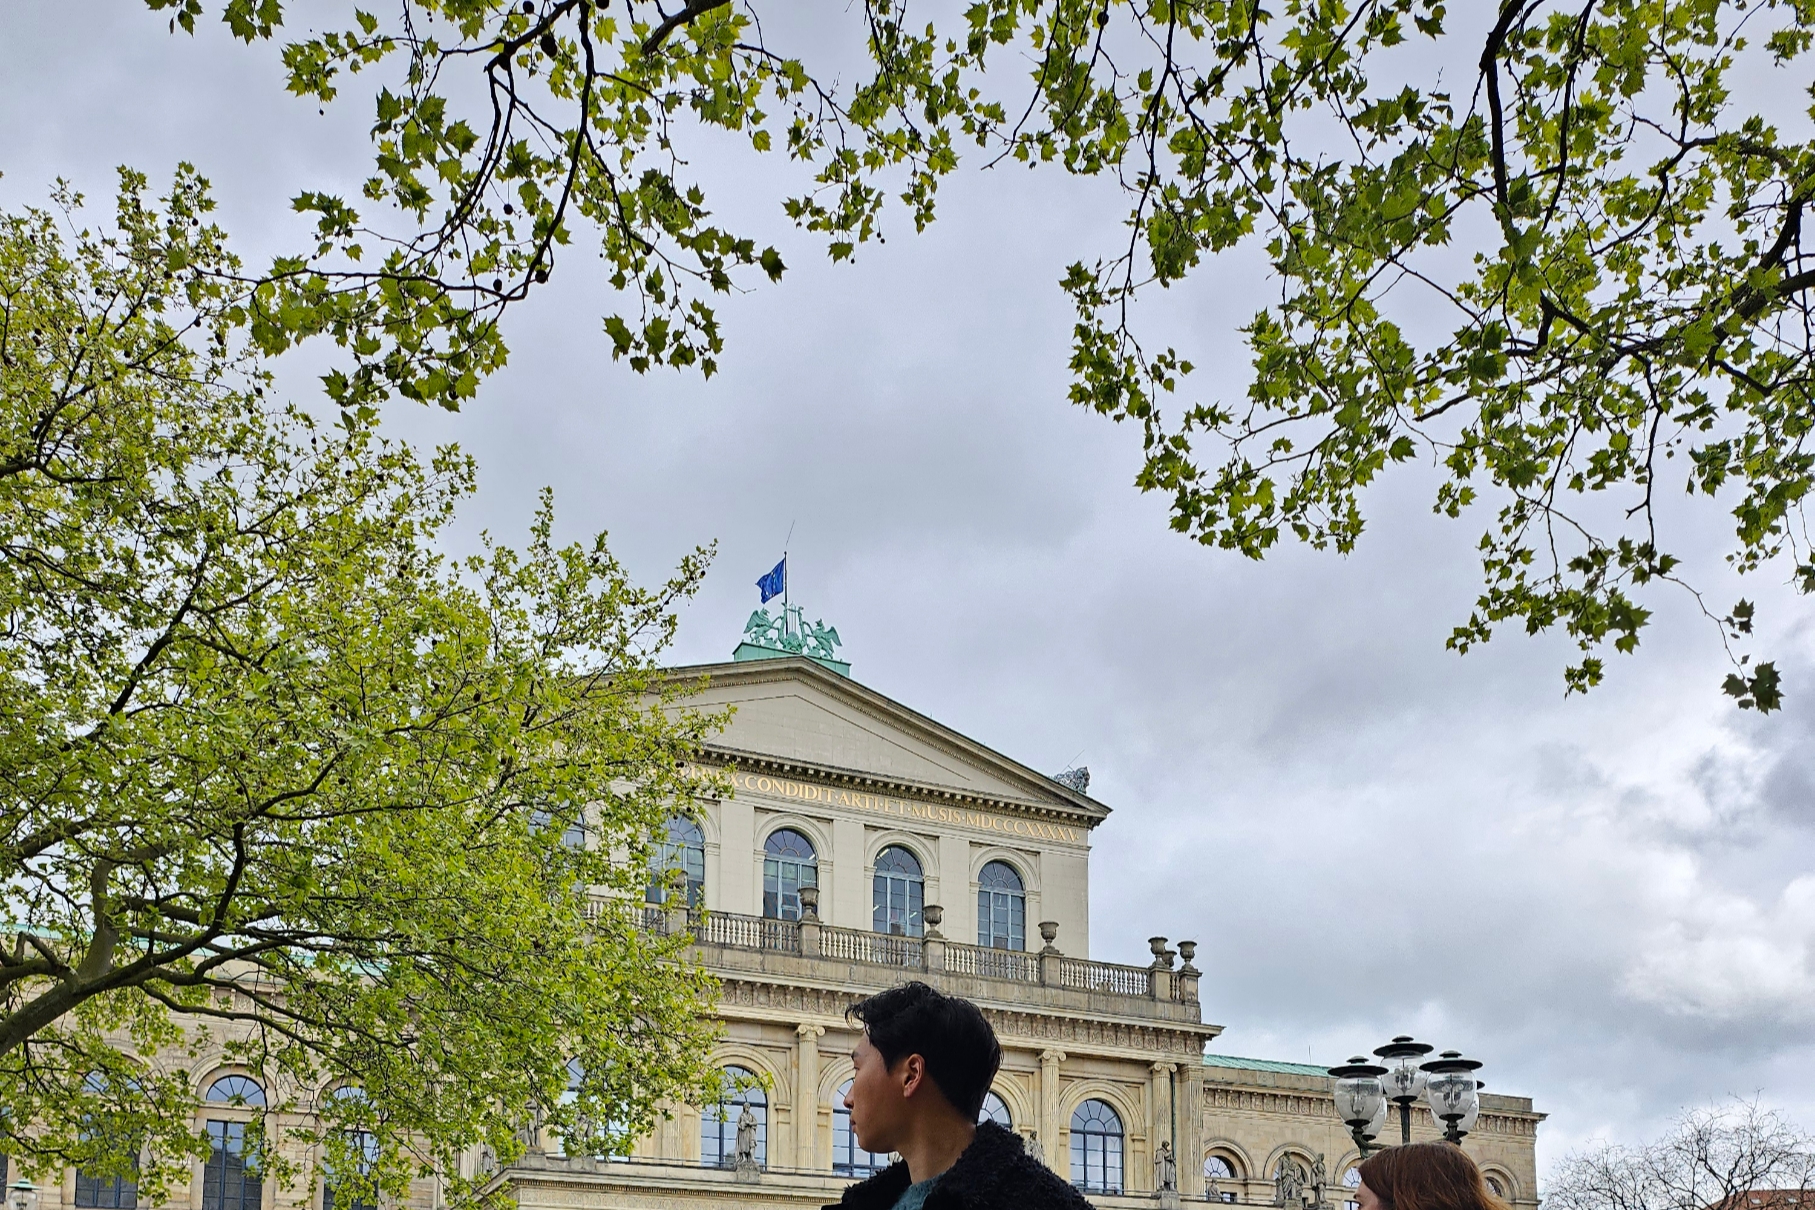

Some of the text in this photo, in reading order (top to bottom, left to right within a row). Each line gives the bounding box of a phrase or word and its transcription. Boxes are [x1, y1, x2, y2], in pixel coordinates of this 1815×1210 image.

[744, 775, 836, 803] CONDIDIT
[838, 790, 879, 811] ARTI
[884, 797, 909, 815] ET
[911, 801, 961, 824] MUSIS
